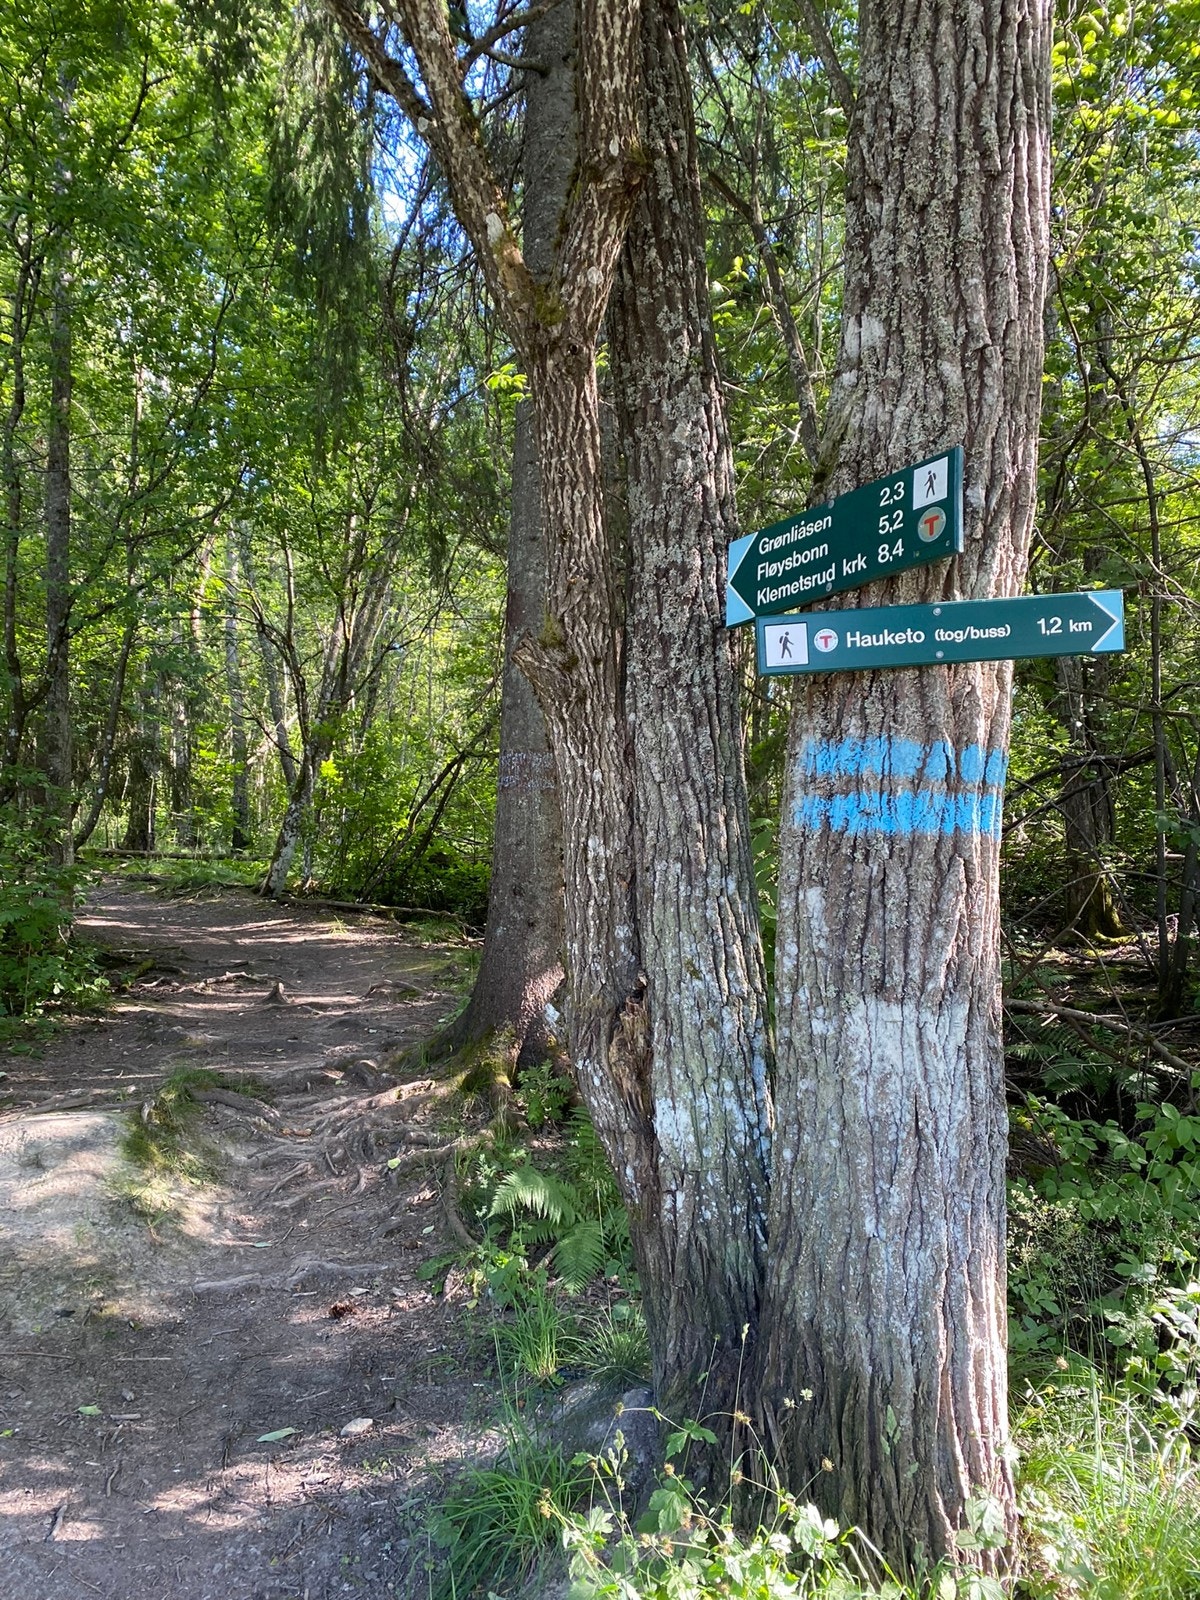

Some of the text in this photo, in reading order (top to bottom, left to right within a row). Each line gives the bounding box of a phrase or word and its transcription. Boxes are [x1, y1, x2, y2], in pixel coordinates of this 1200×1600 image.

[757, 510, 904, 581] Fløysbonn 5,2
[758, 481, 905, 554] Grønliåsen 2,3
[757, 539, 904, 606] Klemetsrud krk 8,4
[846, 630, 925, 648] Hauketo
[934, 623, 1011, 643] (tog/buss)
[1037, 616, 1062, 636] 1,2
[1069, 619, 1092, 633] km
